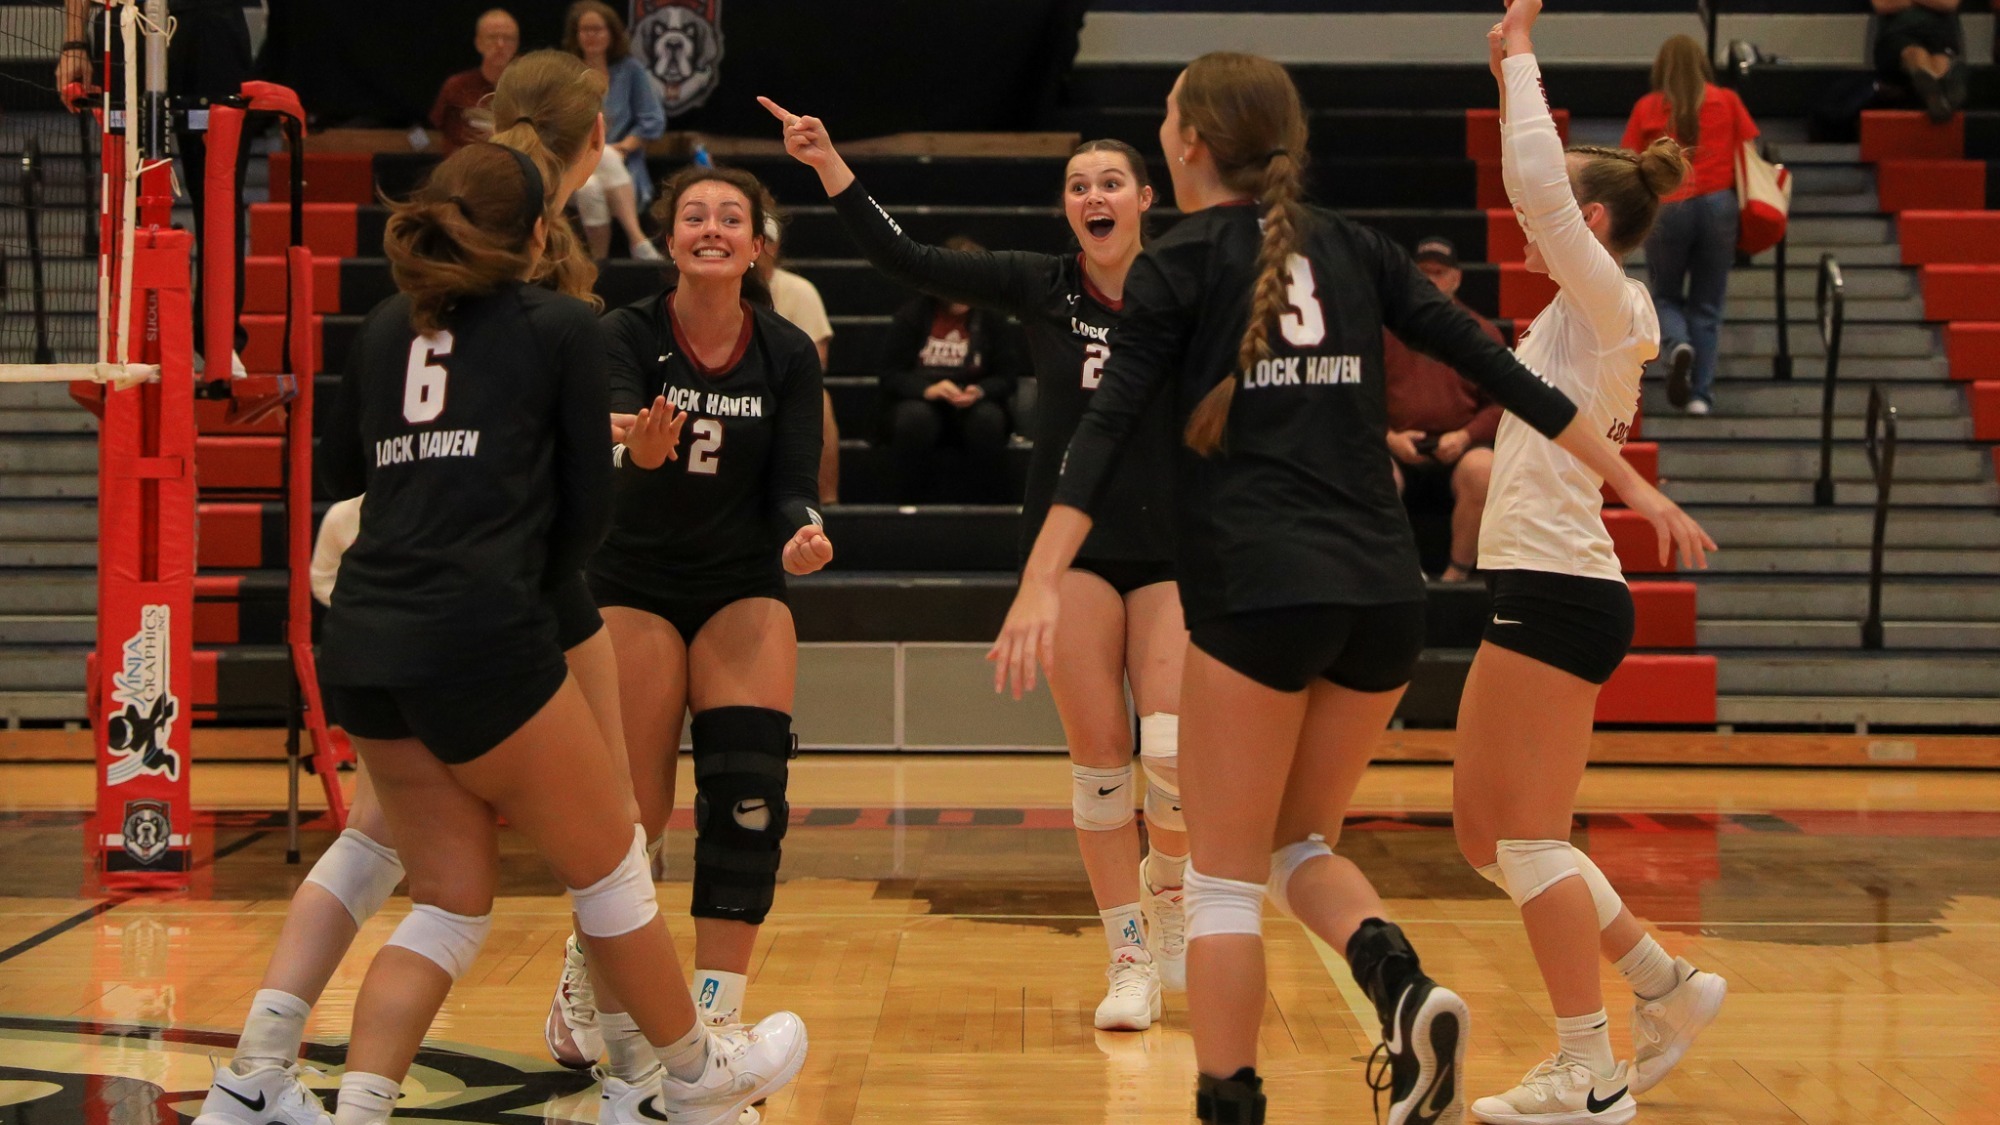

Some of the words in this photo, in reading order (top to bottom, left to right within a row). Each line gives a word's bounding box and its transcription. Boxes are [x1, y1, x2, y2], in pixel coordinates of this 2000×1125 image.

[1278, 252, 1327, 348] 3
[1070, 316, 1110, 344] LOCK
[401, 330, 455, 424] 6
[1081, 342, 1112, 390] 2
[1243, 356, 1301, 389] LOCK
[1305, 355, 1361, 385] HAVEN
[705, 392, 763, 417] HAVEN
[376, 434, 415, 468] LOCK
[419, 430, 480, 460] HAVEN
[686, 417, 724, 475] 2
[117, 637, 146, 711] NINJA
[144, 609, 157, 702] GRAPHICS
